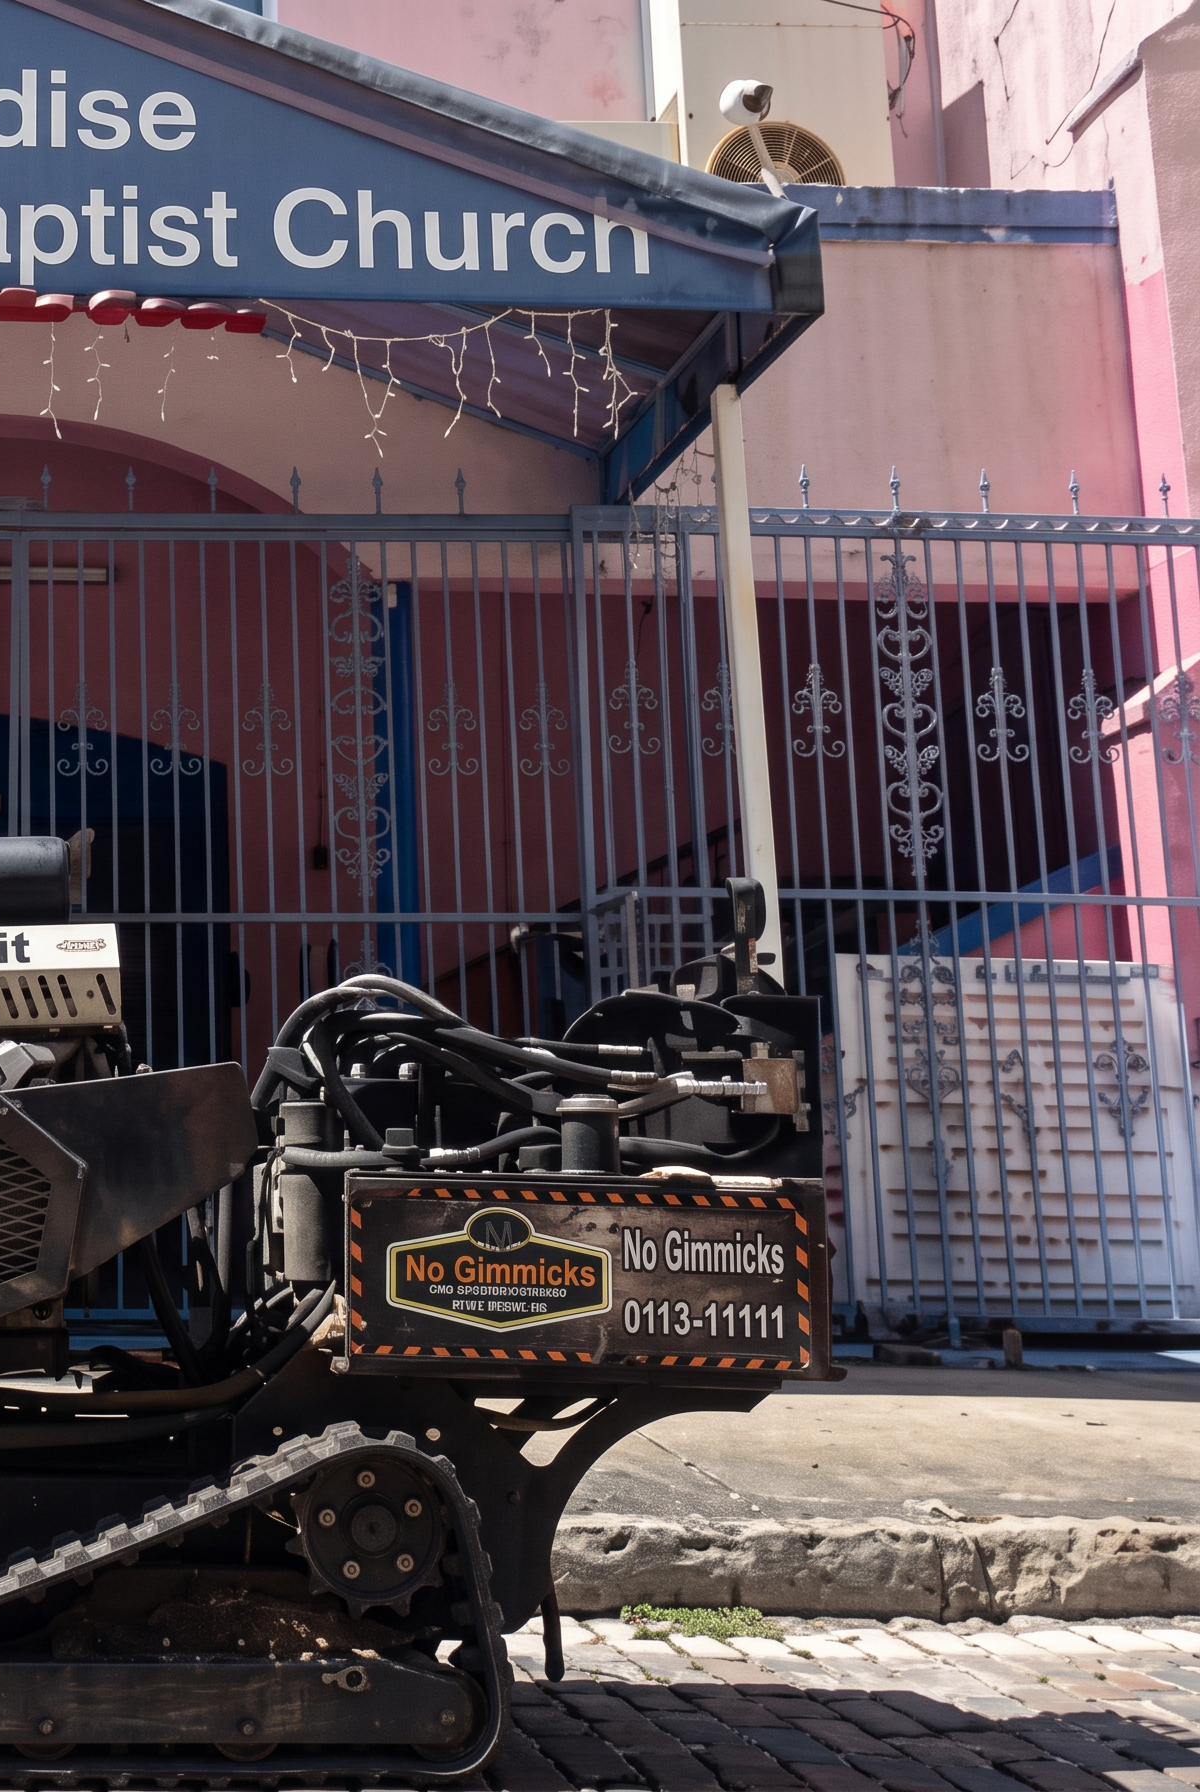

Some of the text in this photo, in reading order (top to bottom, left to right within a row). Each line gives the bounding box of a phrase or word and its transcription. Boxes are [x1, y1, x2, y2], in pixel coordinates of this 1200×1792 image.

[272, 186, 650, 275] Church
[406, 1254, 596, 1287] No Gimmicks
[623, 1228, 785, 1275] No Gimmicks
[624, 1299, 784, 1339] 0113-11111
